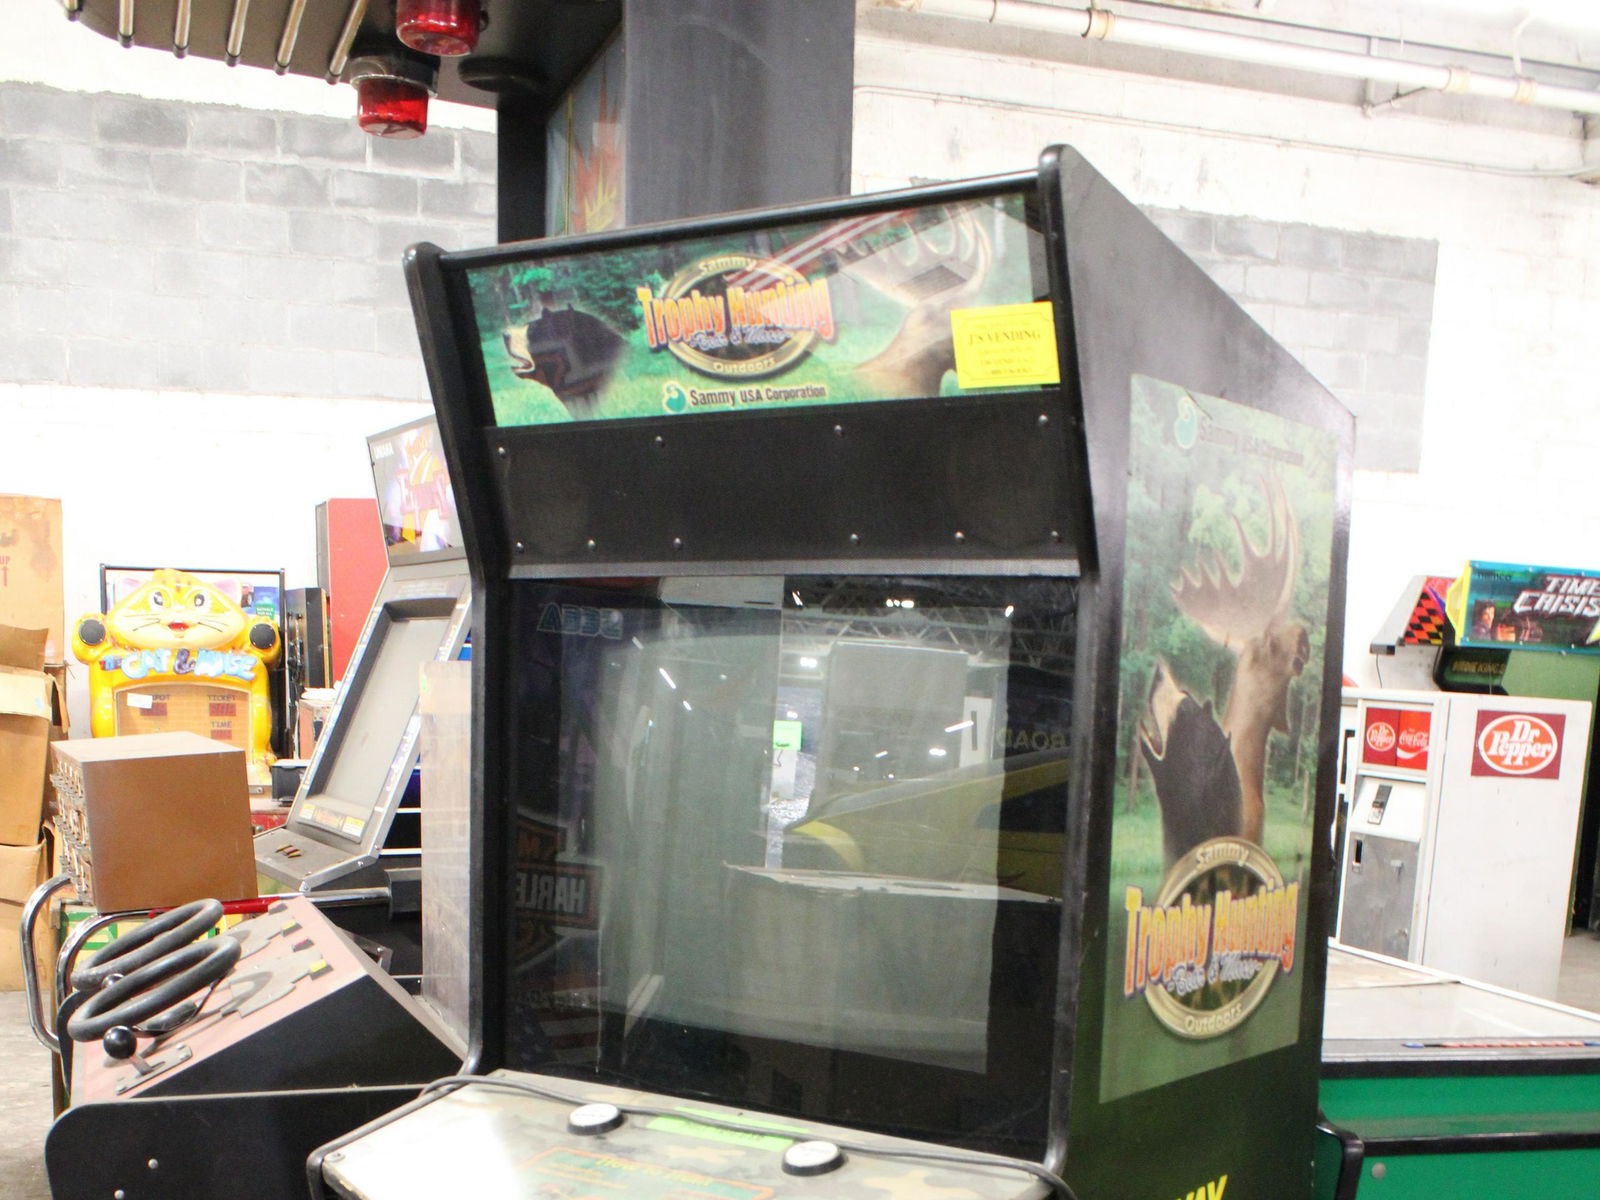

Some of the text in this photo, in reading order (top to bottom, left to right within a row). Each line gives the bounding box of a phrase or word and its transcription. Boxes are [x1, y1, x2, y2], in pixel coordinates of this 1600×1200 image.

[699, 257, 757, 274] Sammy
[636, 278, 835, 349] Trophy Hunting
[712, 357, 776, 374] Outdoors
[690, 384, 827, 406] Sammy USA Corporation
[1545, 575, 1600, 596] TIME
[1513, 590, 1600, 617] CRISIS
[121, 648, 172, 680] CAT
[173, 648, 196, 675] &
[211, 720, 232, 728] TIME
[1509, 720, 1540, 743] Dr
[1370, 729, 1394, 747] Pepper
[1488, 731, 1552, 766] Pepper
[1124, 877, 1299, 998] Trophy Hunting
[1184, 1002, 1243, 1032] Outdoors
